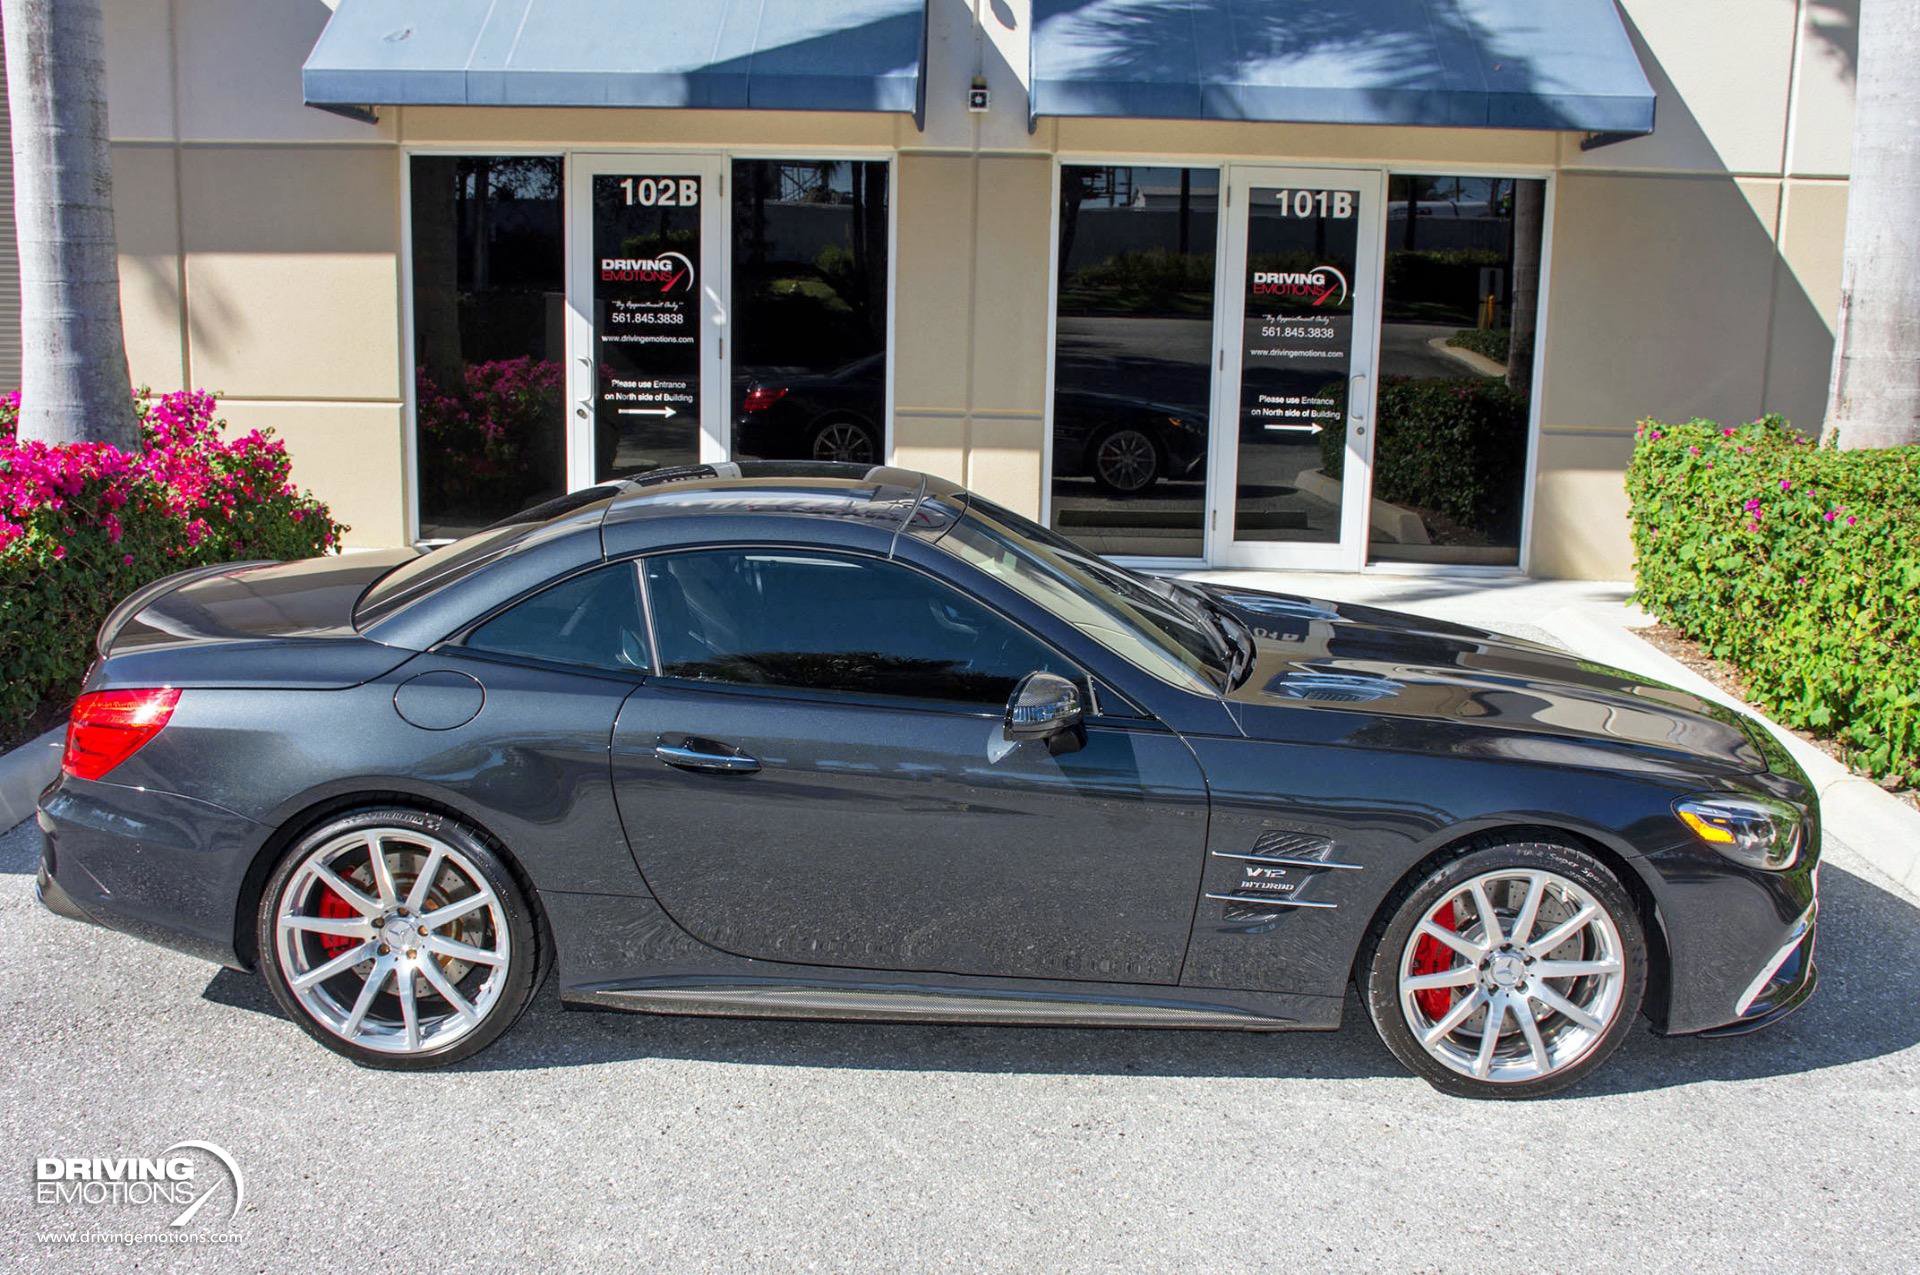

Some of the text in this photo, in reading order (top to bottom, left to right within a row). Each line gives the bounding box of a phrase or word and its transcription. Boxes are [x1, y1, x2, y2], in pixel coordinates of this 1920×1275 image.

[620, 178, 698, 207] 102B
[1275, 189, 1352, 219] 101B
[602, 259, 673, 271] DRIVING
[602, 270, 673, 281] EMOTIONS
[1253, 272, 1326, 285] DRIVING
[1253, 283, 1326, 296] EMOTIONS
[612, 312, 684, 324] 561.845.3838
[1261, 326, 1335, 339] 561.845.3838
[601, 335, 695, 344] www.drivingemotions.com
[1250, 349, 1344, 358] www.drivingemotions.com
[611, 379, 637, 388] Please
[653, 380, 687, 389] Entrance
[616, 393, 637, 401] North
[638, 393, 653, 401] side
[654, 393, 663, 401] of
[664, 393, 694, 403] Building
[1258, 394, 1285, 404] Please
[1301, 396, 1335, 406] Entrance
[1262, 408, 1284, 416] North
[1284, 408, 1300, 417] side
[1301, 409, 1310, 417] of
[1310, 409, 1341, 420] Building
[1246, 867, 1287, 878] V12
